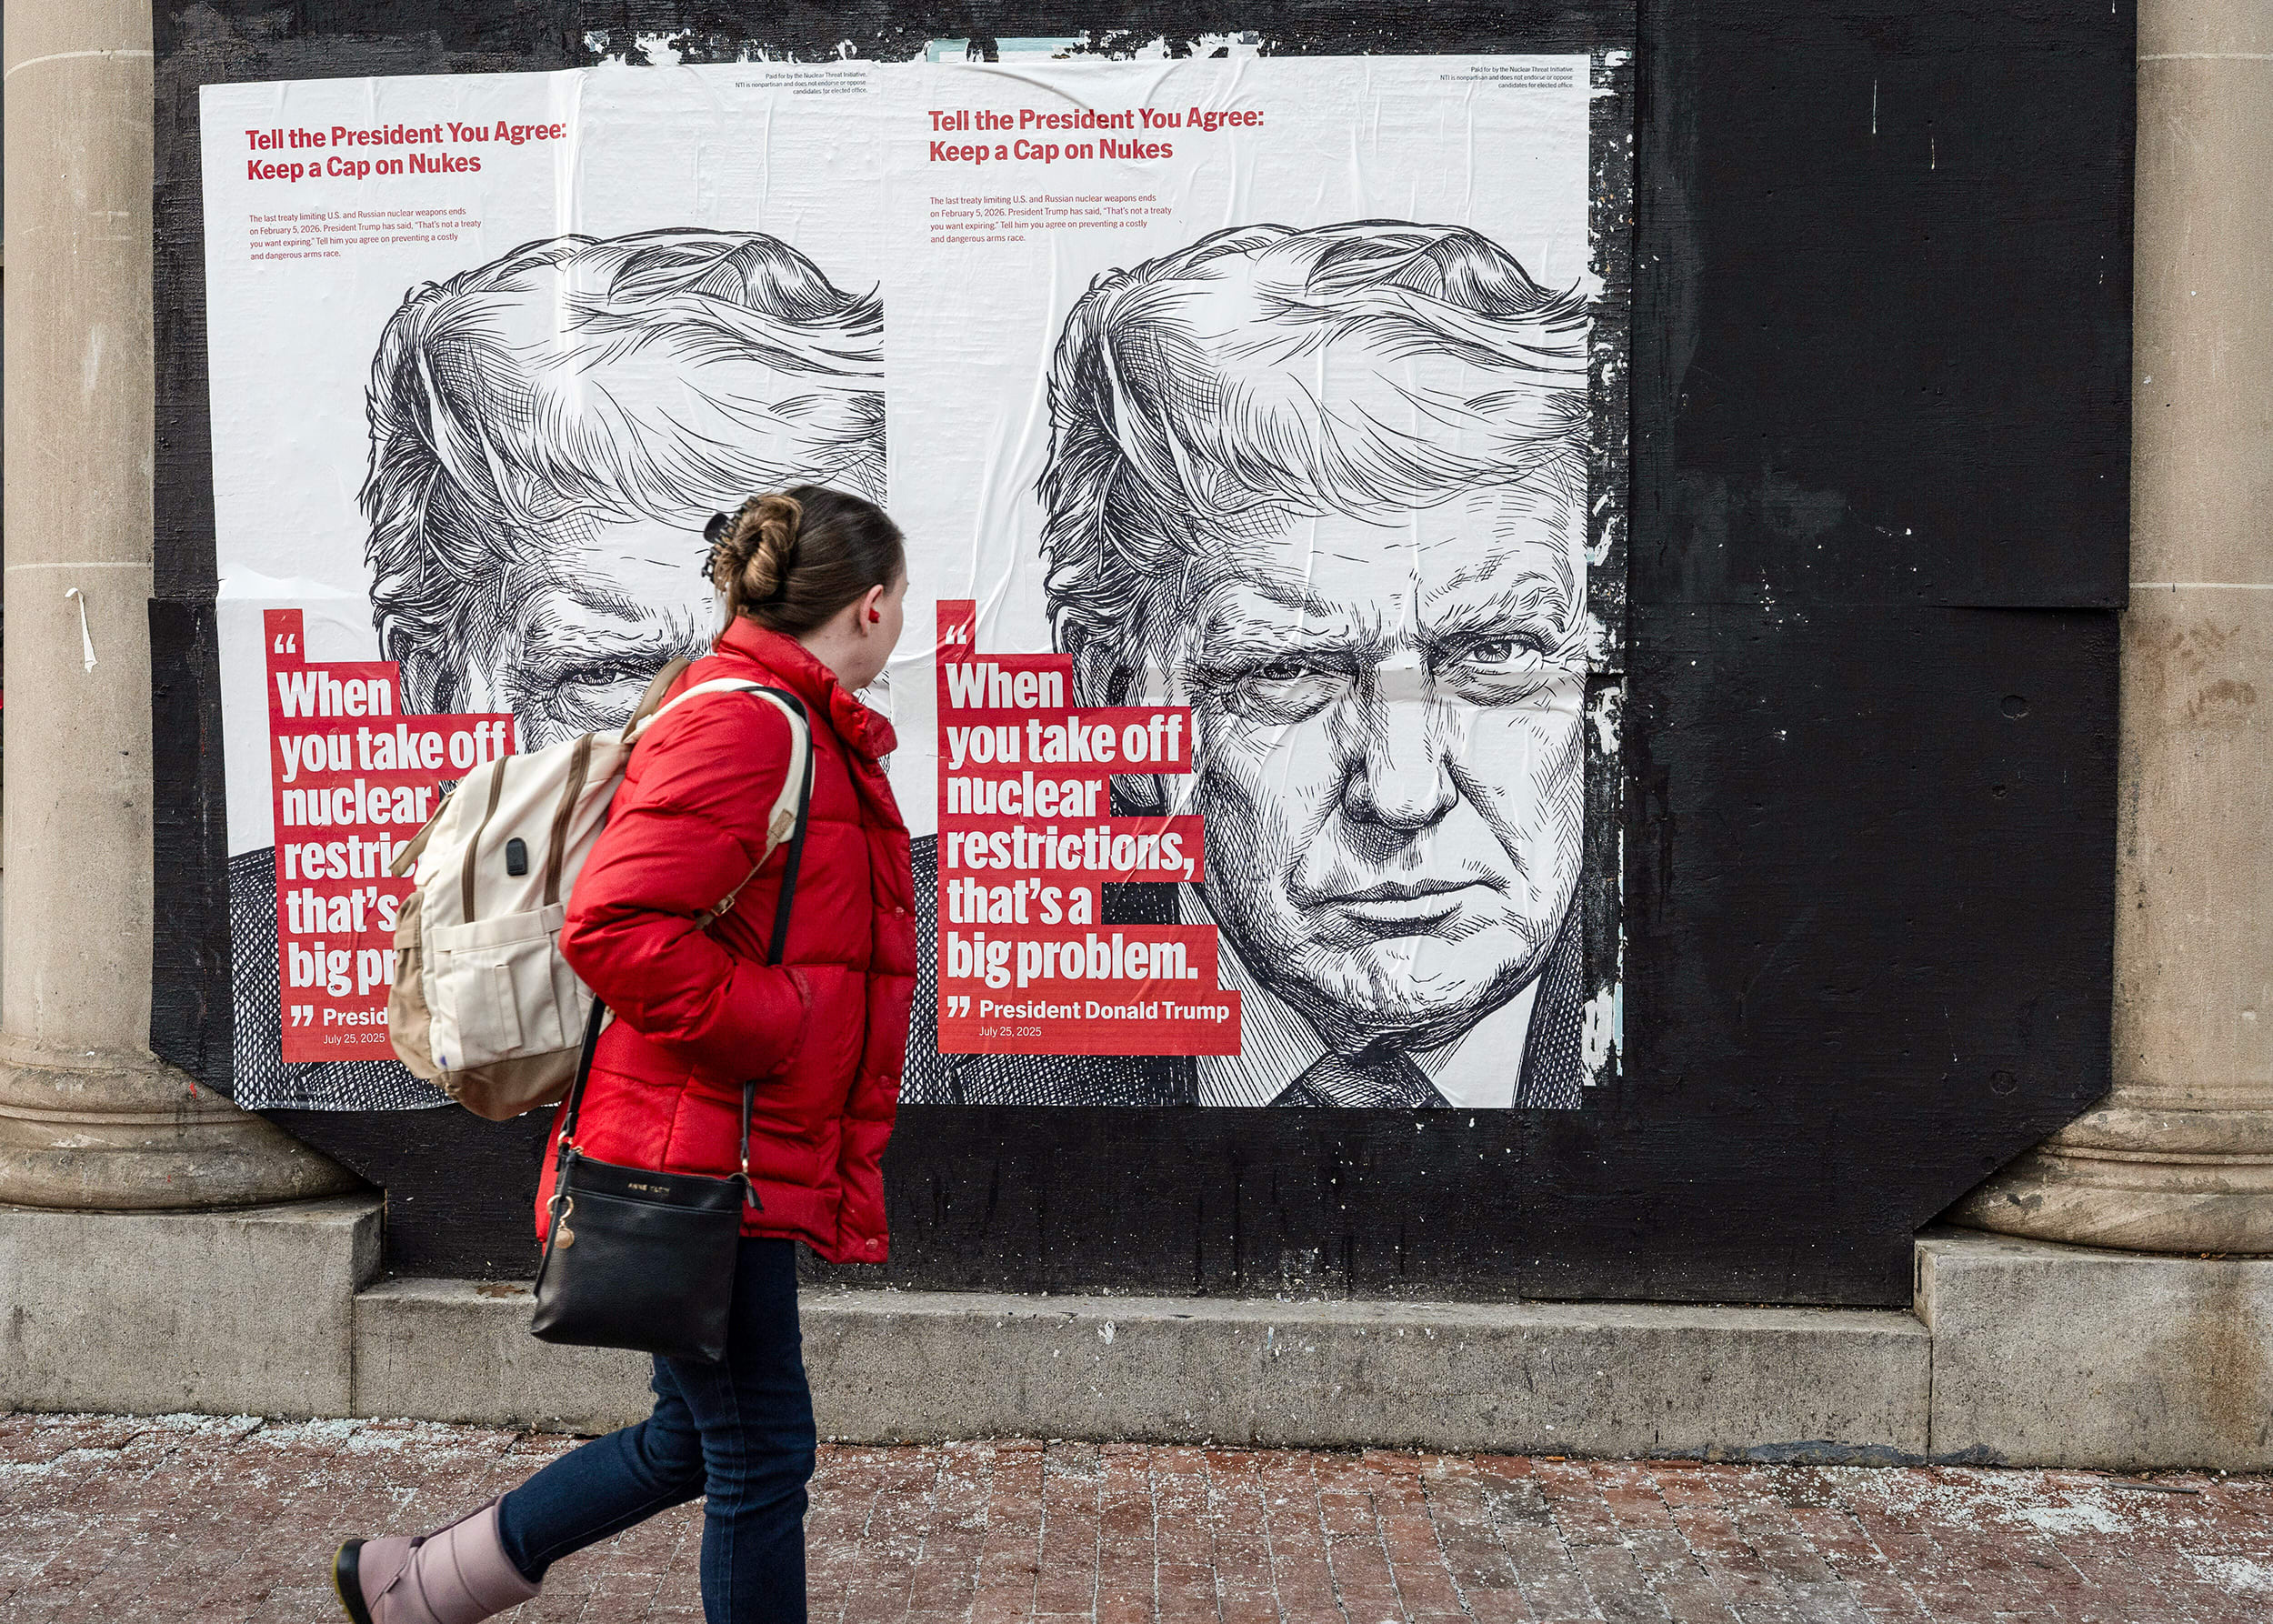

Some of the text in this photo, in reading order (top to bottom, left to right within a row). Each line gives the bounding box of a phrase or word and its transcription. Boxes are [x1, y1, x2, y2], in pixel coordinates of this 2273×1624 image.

[928, 107, 1264, 132] Tell the President You Agree:
[245, 121, 566, 150] Tell the President You Agree:
[930, 138, 1173, 165] Keep a Cap on Nukes
[247, 153, 481, 183] Keep a Cap on Nukes
[930, 196, 944, 205] The
[946, 196, 958, 205] last
[960, 196, 982, 205] treaty
[984, 195, 1011, 205] limiting
[1013, 195, 1027, 203] U.S.
[1029, 195, 1043, 203] and
[1045, 195, 1073, 203] Russian
[1138, 194, 1157, 202] ends
[941, 209, 974, 218] February
[976, 208, 982, 217] 5,
[984, 208, 1006, 216] 2026.
[1007, 207, 1043, 216] President
[1044, 207, 1068, 216] Trump
[1085, 207, 1101, 216] said,
[1150, 206, 1171, 216] treaty
[260, 225, 291, 235] February
[293, 226, 298, 234] 5,
[300, 225, 321, 233] 2026.
[323, 224, 356, 232] President
[357, 223, 380, 231] Trump
[382, 222, 395, 230] has
[396, 222, 413, 233] said,
[460, 220, 481, 228] treaty
[278, 214, 298, 222] treaty
[299, 212, 325, 221] limiting
[327, 211, 341, 219] U.S.
[358, 210, 386, 218] Russian
[387, 209, 413, 217] nuclear
[946, 222, 963, 230] want
[1078, 220, 1117, 229] preventing
[1126, 219, 1147, 228] costly
[250, 241, 263, 249] you
[315, 236, 327, 245] Tell
[345, 237, 357, 246] you
[359, 236, 378, 245] agree
[391, 234, 429, 244] preventing
[436, 233, 458, 241] costly
[931, 235, 944, 243] and
[946, 235, 985, 244] dangerous
[250, 252, 264, 260] and
[265, 252, 302, 260] dangerous
[276, 671, 392, 717] When
[946, 663, 1064, 708] When
[279, 721, 506, 783] you take off
[946, 715, 1182, 769] you take off
[283, 778, 432, 826] nuclear
[947, 771, 1102, 817] nuclear
[947, 826, 1195, 880] restrictions,
[285, 887, 398, 934] that’s
[947, 877, 1092, 925] that’s a
[288, 942, 352, 997] big
[947, 931, 1198, 989] big problem.
[980, 1000, 1229, 1023] President Donald Trump
[324, 1033, 385, 1045] July 25, 2025
[979, 1027, 1041, 1038] July 25, 2025
